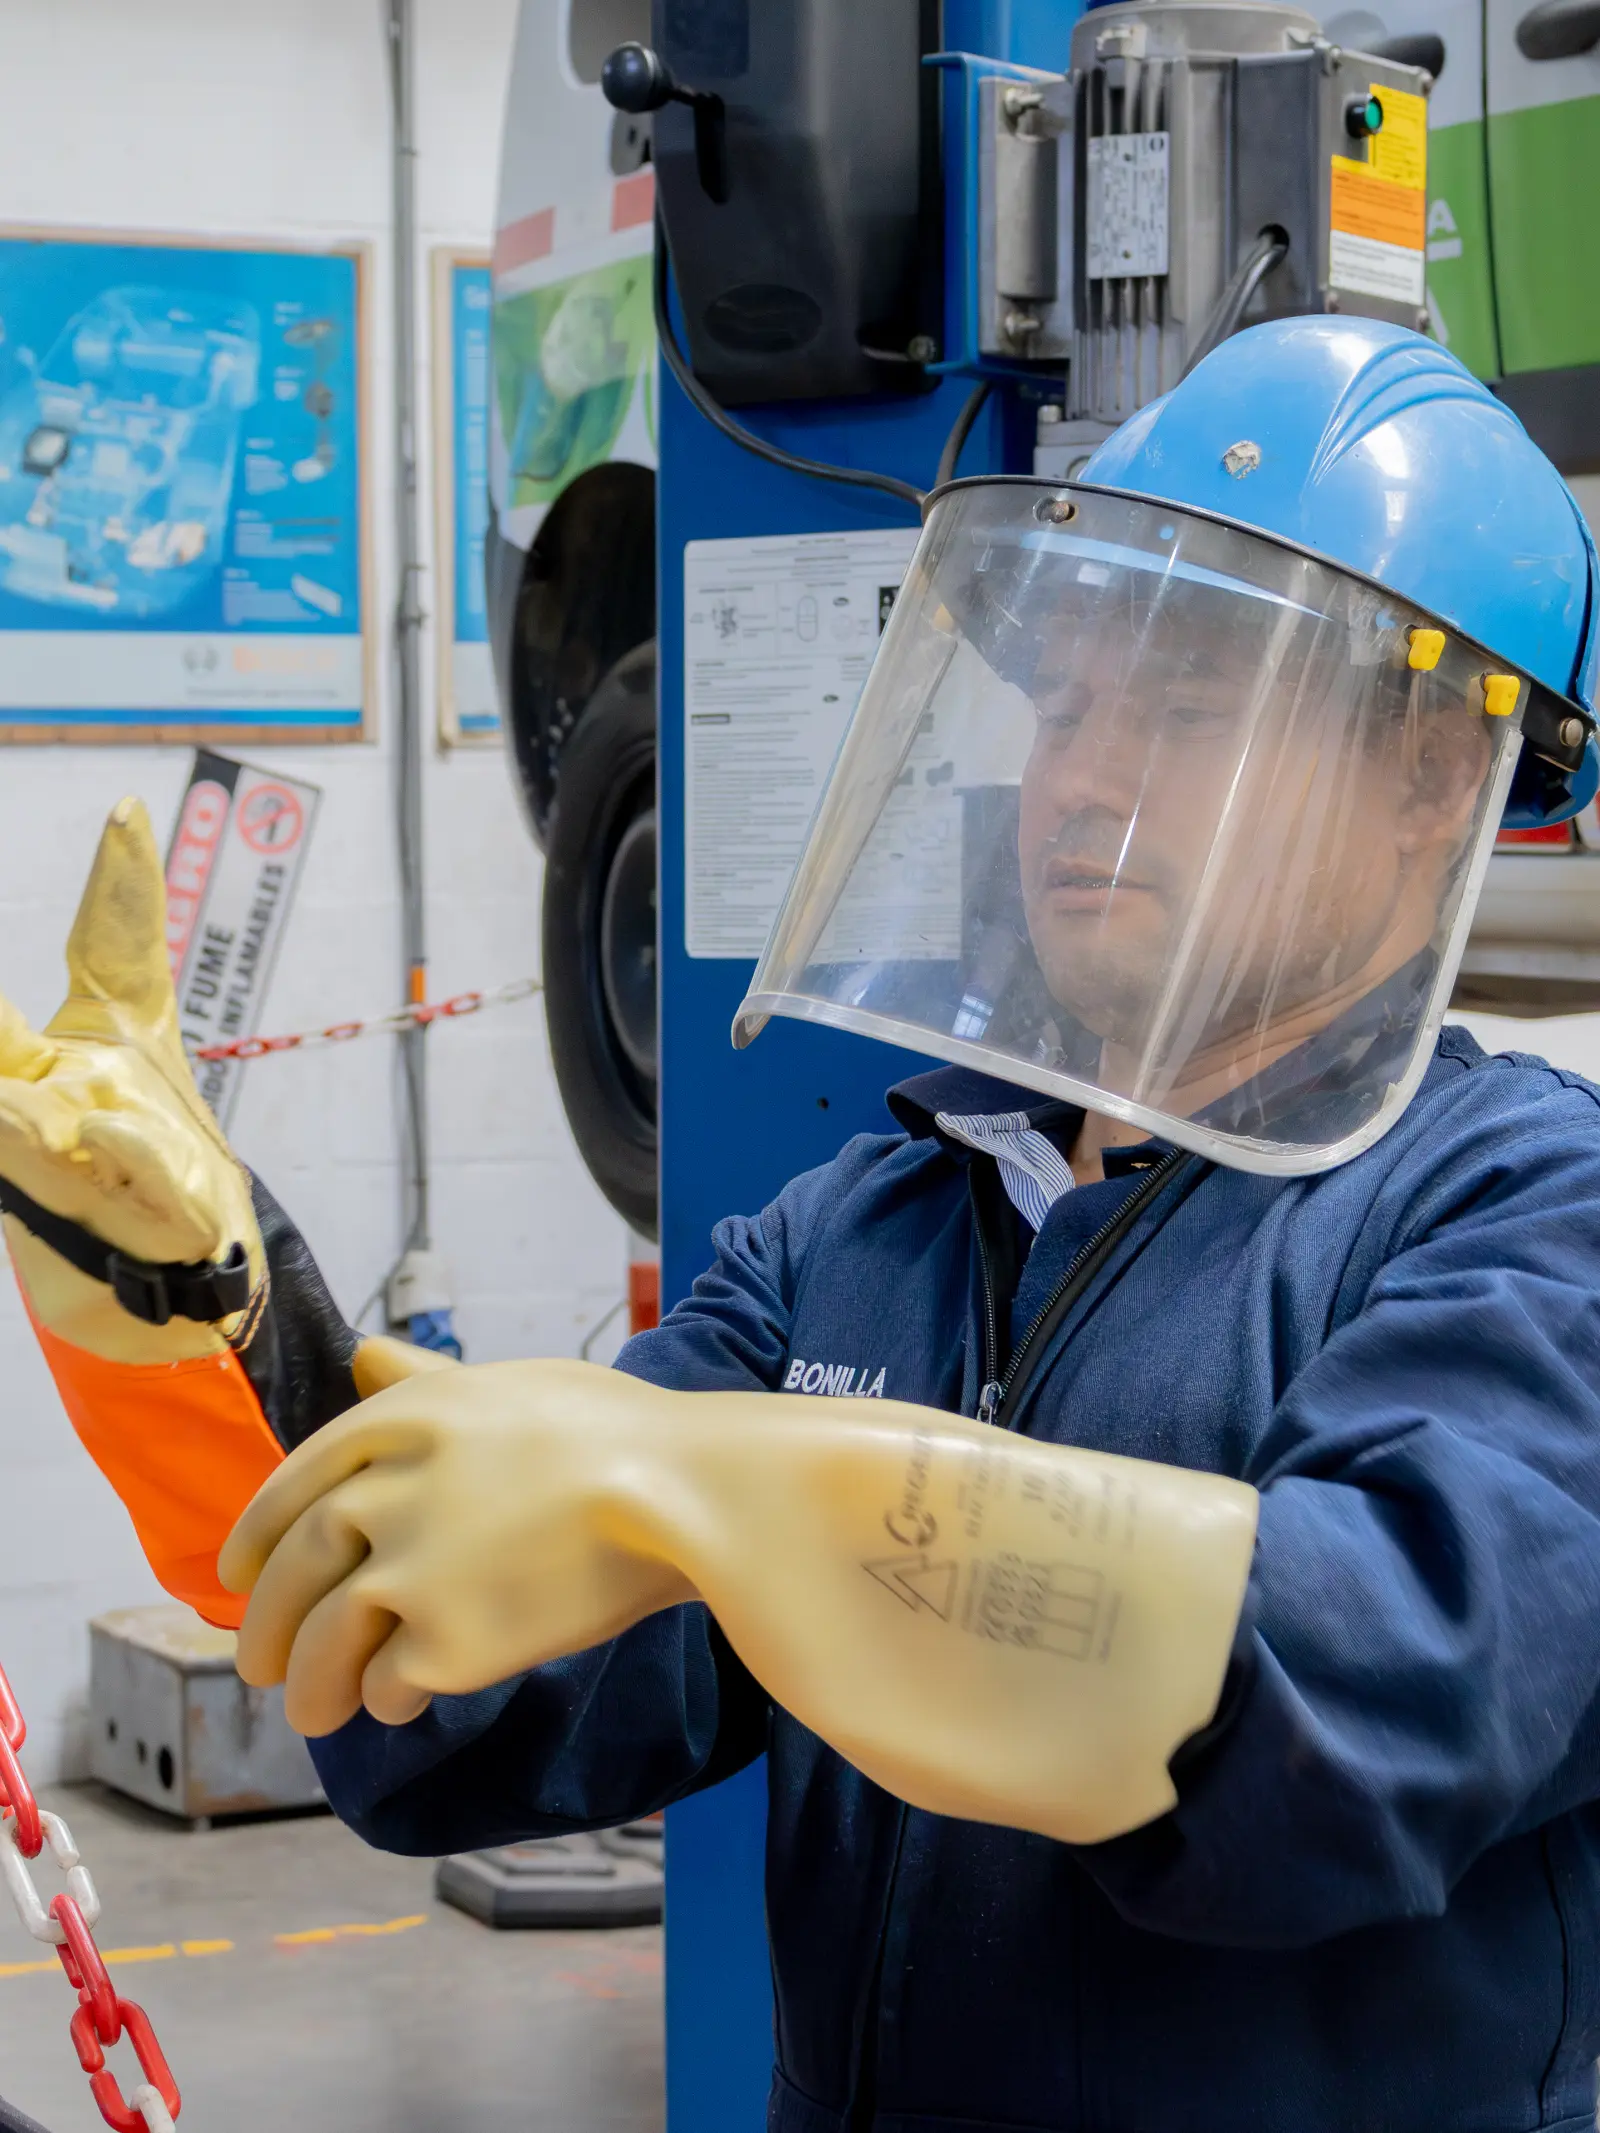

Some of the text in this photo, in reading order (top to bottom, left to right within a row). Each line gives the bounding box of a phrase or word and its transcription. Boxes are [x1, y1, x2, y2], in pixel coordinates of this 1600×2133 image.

[184, 922, 236, 1021] FUME
[219, 861, 287, 1037] INFLAMABLES
[784, 1358, 887, 1398] BONILLA
